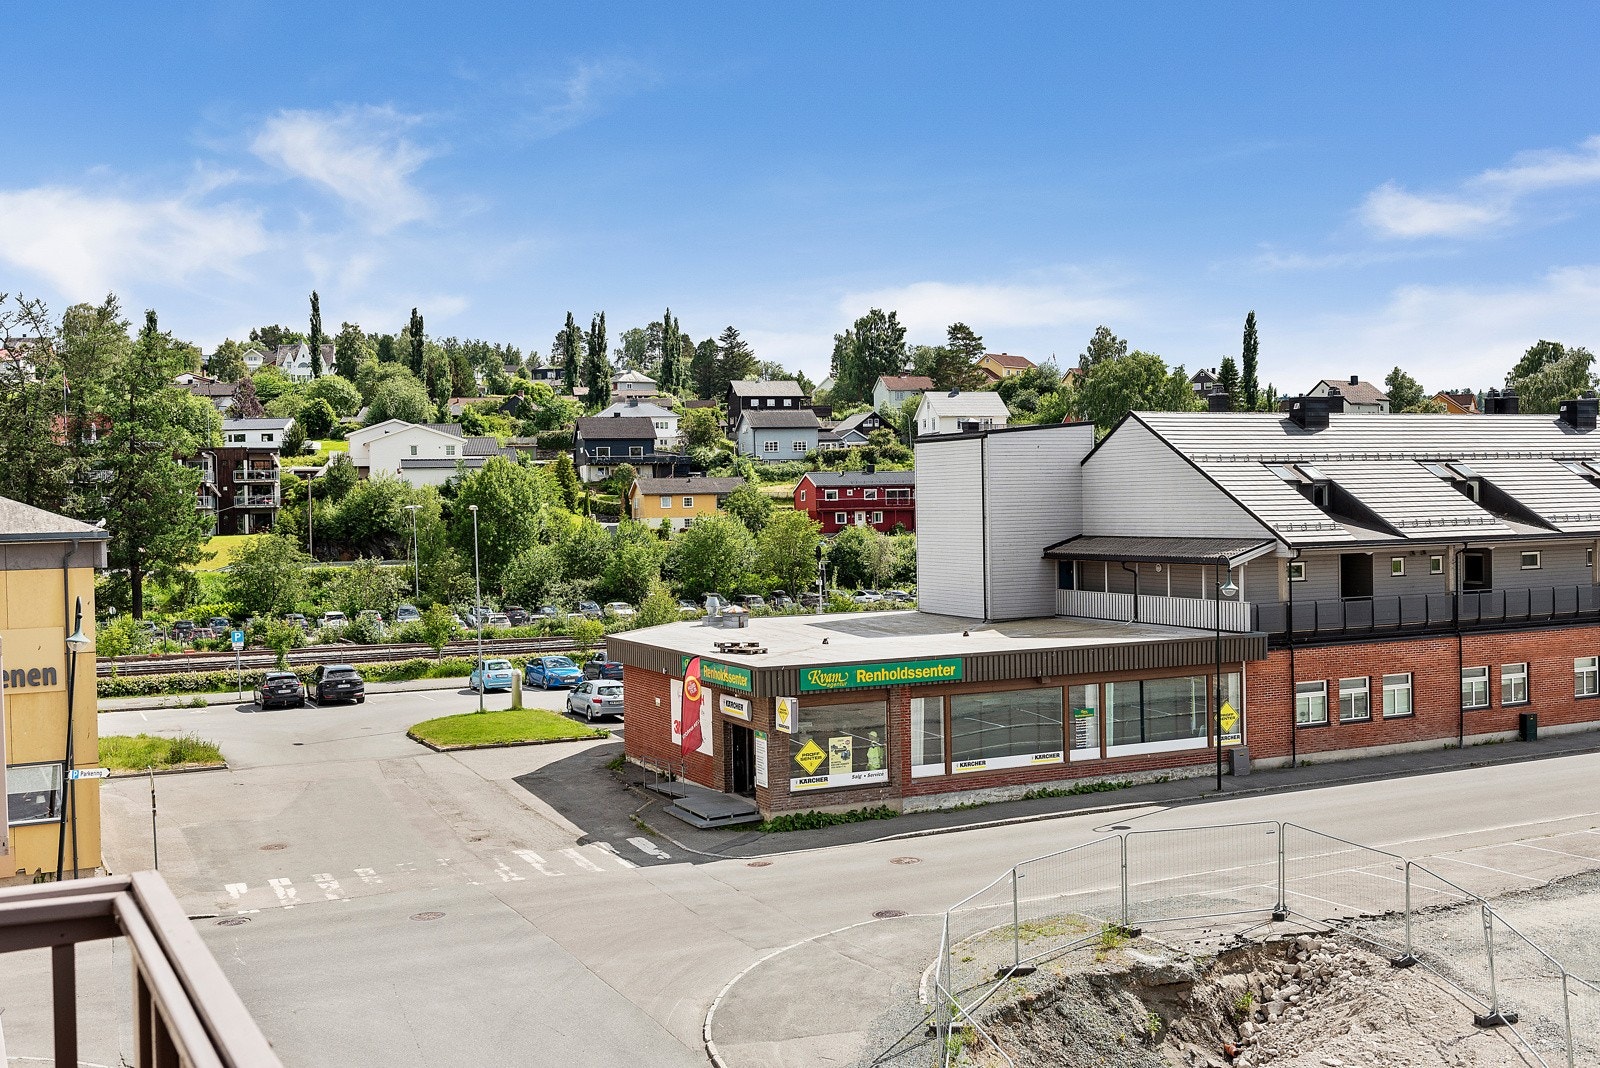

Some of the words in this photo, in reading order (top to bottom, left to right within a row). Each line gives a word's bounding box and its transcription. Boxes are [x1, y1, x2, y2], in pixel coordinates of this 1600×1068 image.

[703, 664, 748, 687] Renholdssenter
[808, 669, 849, 687] Kvam
[856, 664, 956, 683] Renholdssenter
